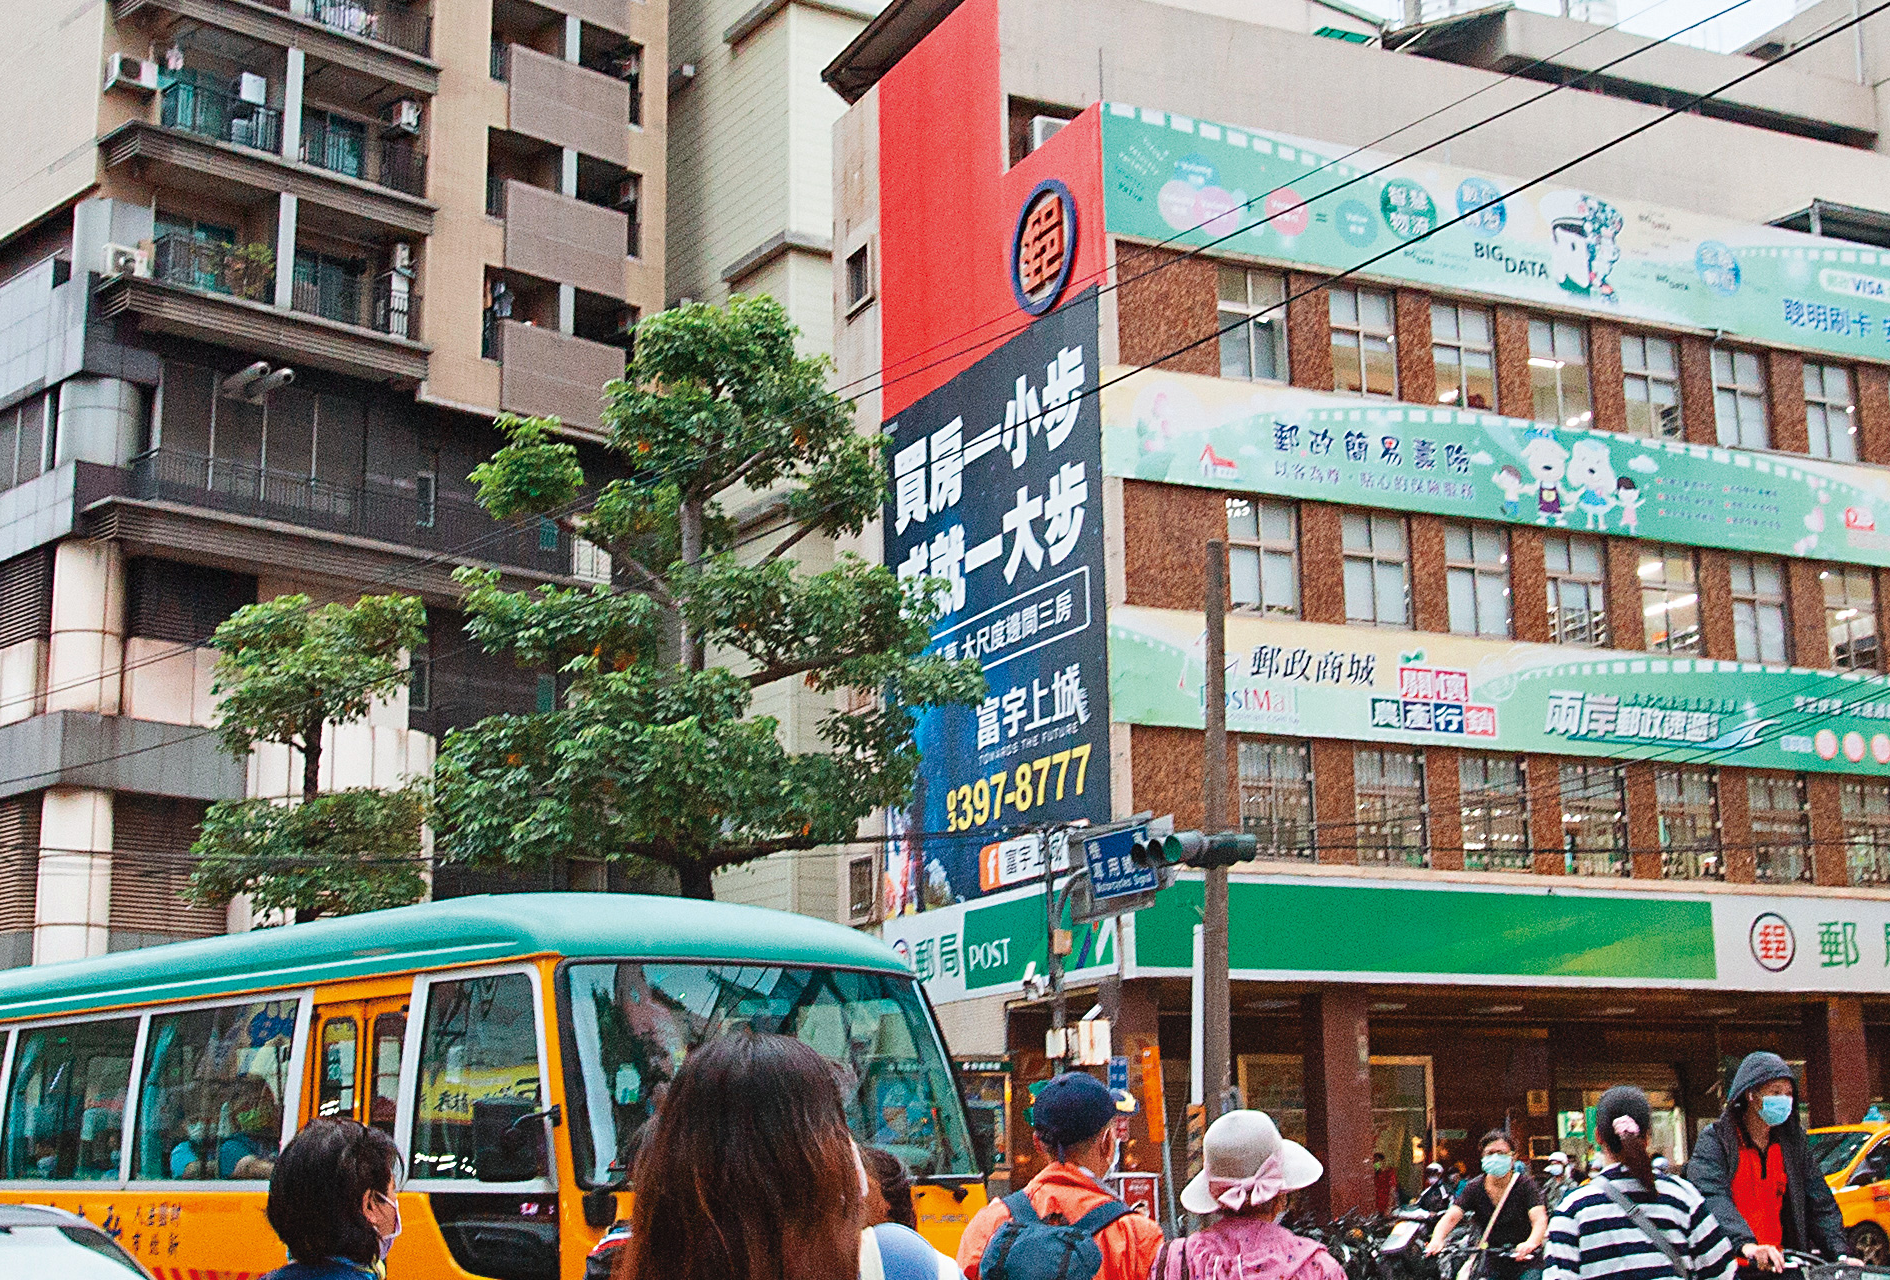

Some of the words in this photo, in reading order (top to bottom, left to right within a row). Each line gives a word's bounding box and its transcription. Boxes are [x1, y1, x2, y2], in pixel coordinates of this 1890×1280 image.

[1474, 242, 1504, 263] BIG
[1504, 255, 1550, 280] DATA
[895, 345, 1086, 537] 買房一小步
[960, 588, 1073, 660] 大尺度邊間三房
[1249, 644, 1377, 688] 郵政商城
[976, 662, 1087, 751] 富宇上城
[968, 937, 1011, 972] POST
